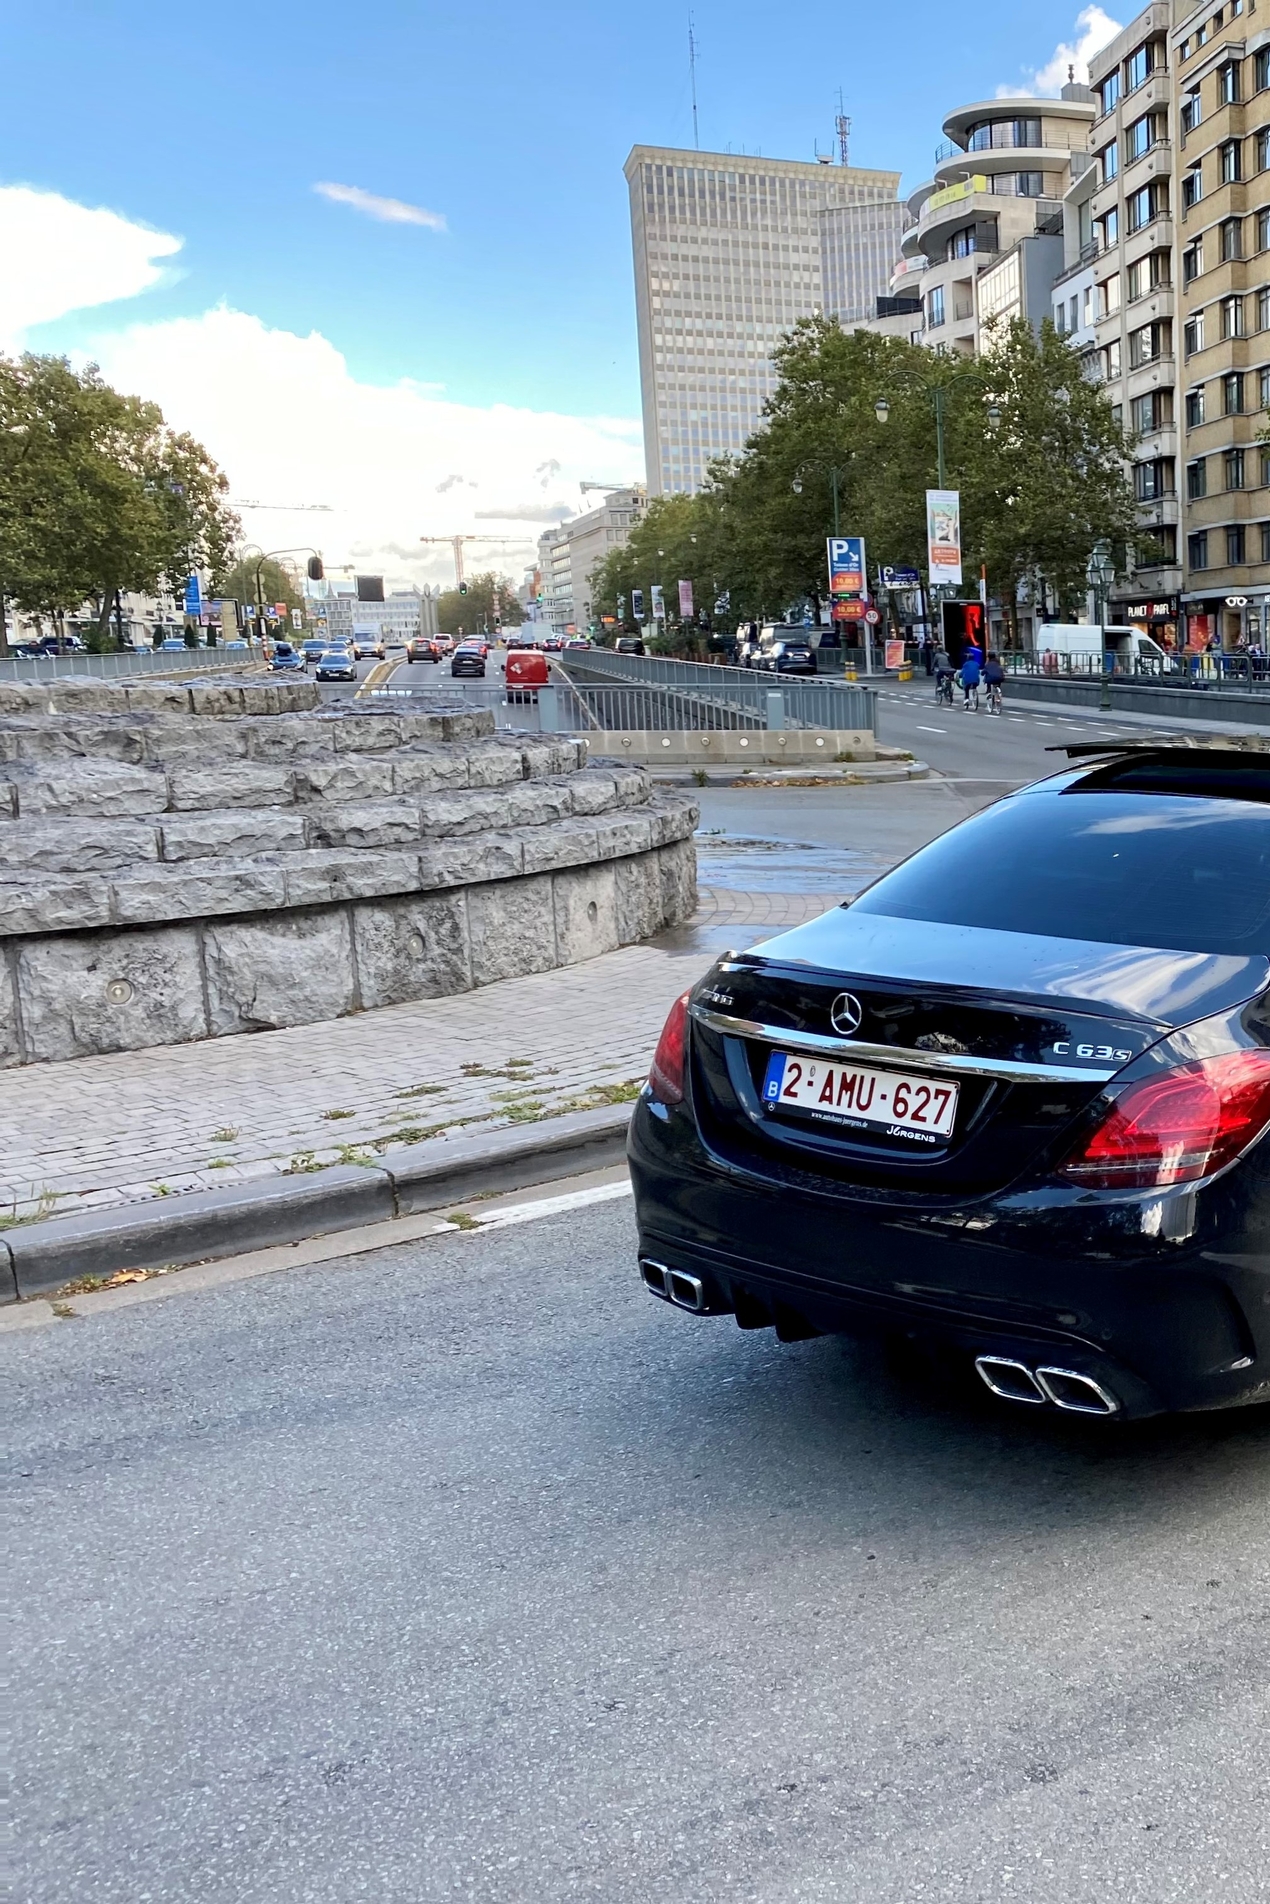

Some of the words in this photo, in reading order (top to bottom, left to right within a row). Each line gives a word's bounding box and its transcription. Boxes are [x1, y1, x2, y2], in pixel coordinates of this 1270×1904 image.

[831, 540, 849, 561] P
[1053, 1041, 1070, 1055] C
[767, 1081, 779, 1098] B
